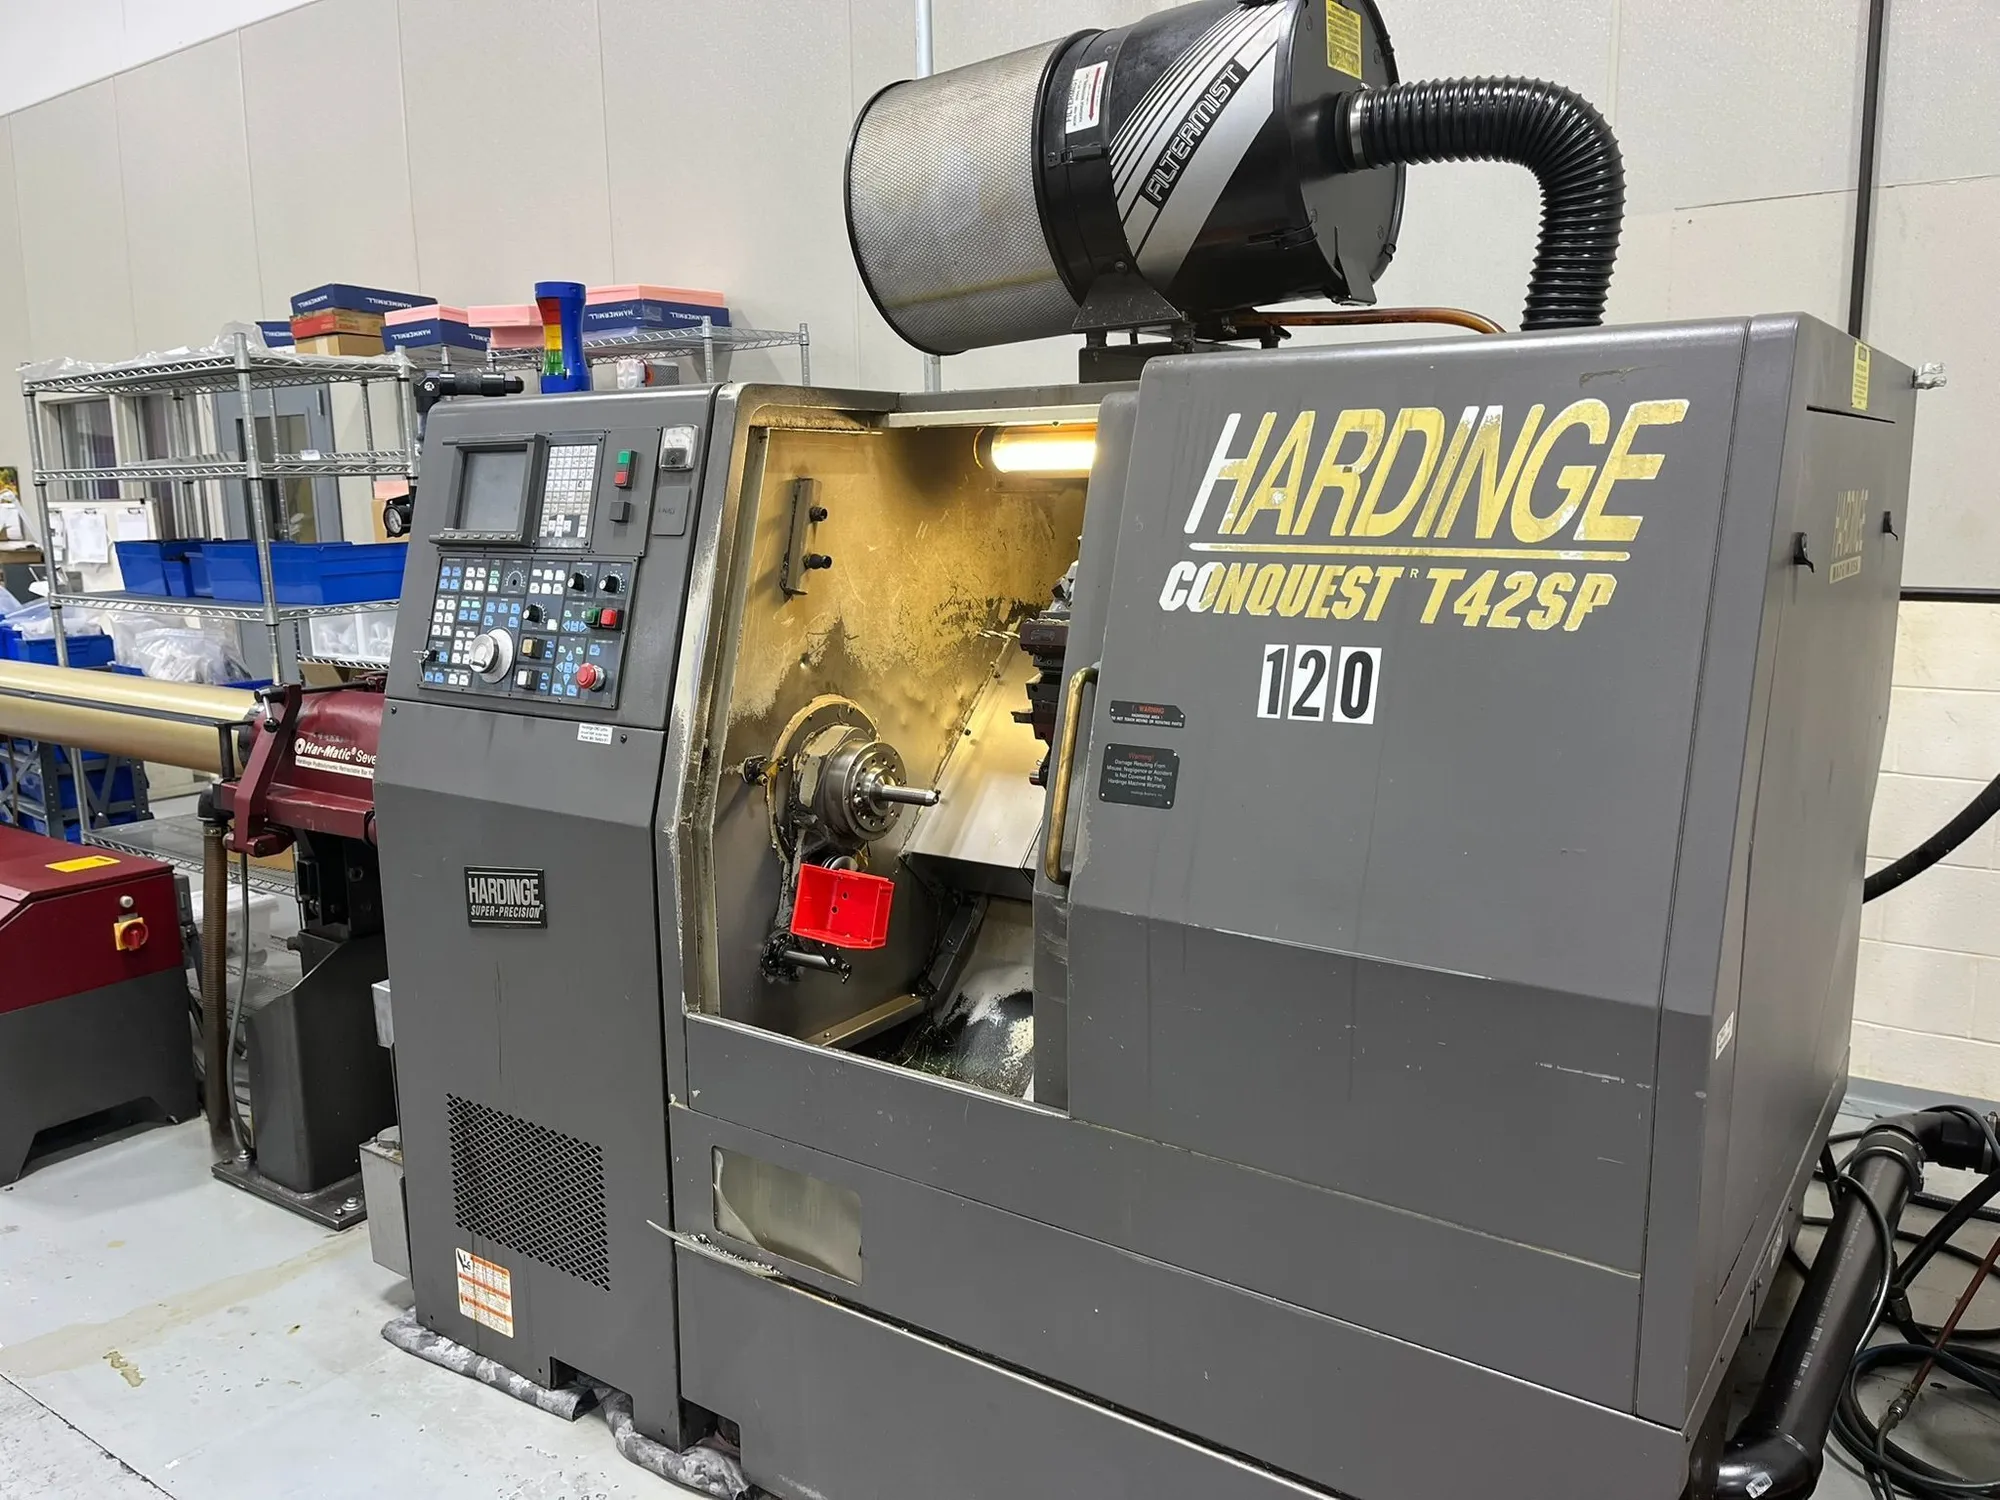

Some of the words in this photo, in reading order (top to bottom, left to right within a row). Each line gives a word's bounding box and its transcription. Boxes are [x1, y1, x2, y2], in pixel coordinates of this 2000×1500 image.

[1145, 63, 1240, 202] FILTERMIST
[297, 295, 328, 309] HAMMERMILL
[588, 309, 634, 320] HAMMERMILL
[391, 329, 432, 341] HAMMERMILL
[1183, 398, 1690, 543] HARDINGE
[1158, 561, 1405, 622] CONQUEST
[1420, 567, 1618, 632] T42SP
[1266, 648, 1374, 720] 120
[468, 877, 540, 906] HARDINGE
